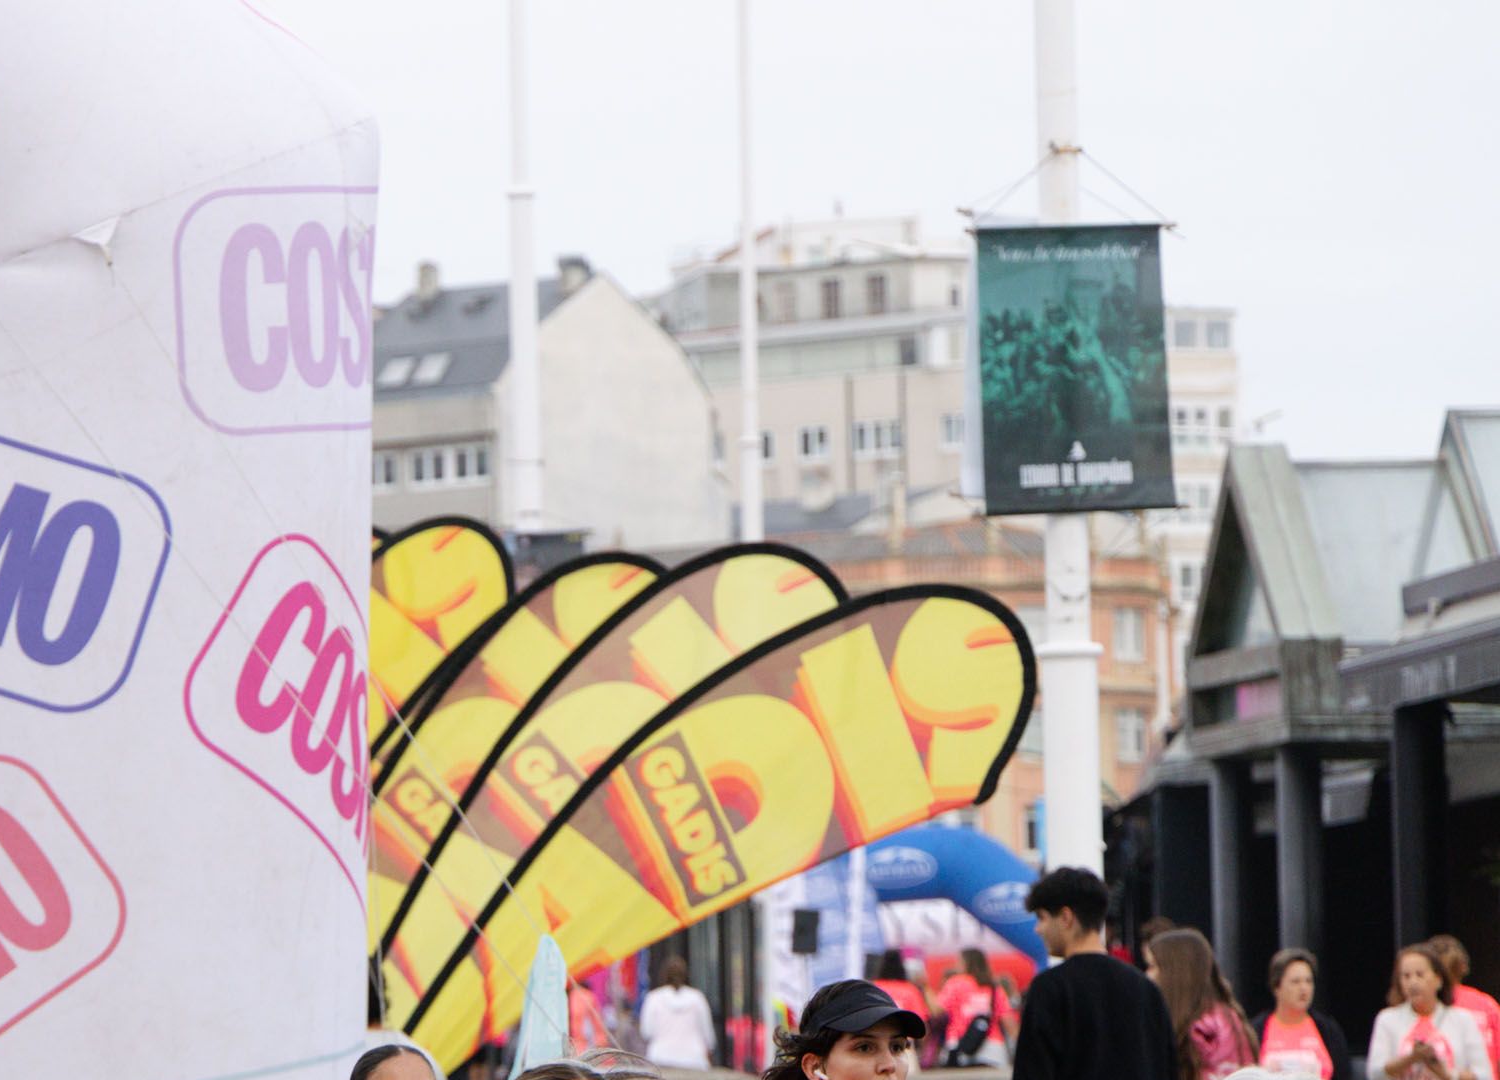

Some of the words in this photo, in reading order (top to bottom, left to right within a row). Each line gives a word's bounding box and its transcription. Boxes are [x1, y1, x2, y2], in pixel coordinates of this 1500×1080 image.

[219, 220, 376, 392] COS
[235, 581, 367, 858] COS
[639, 744, 737, 896] GADIS
